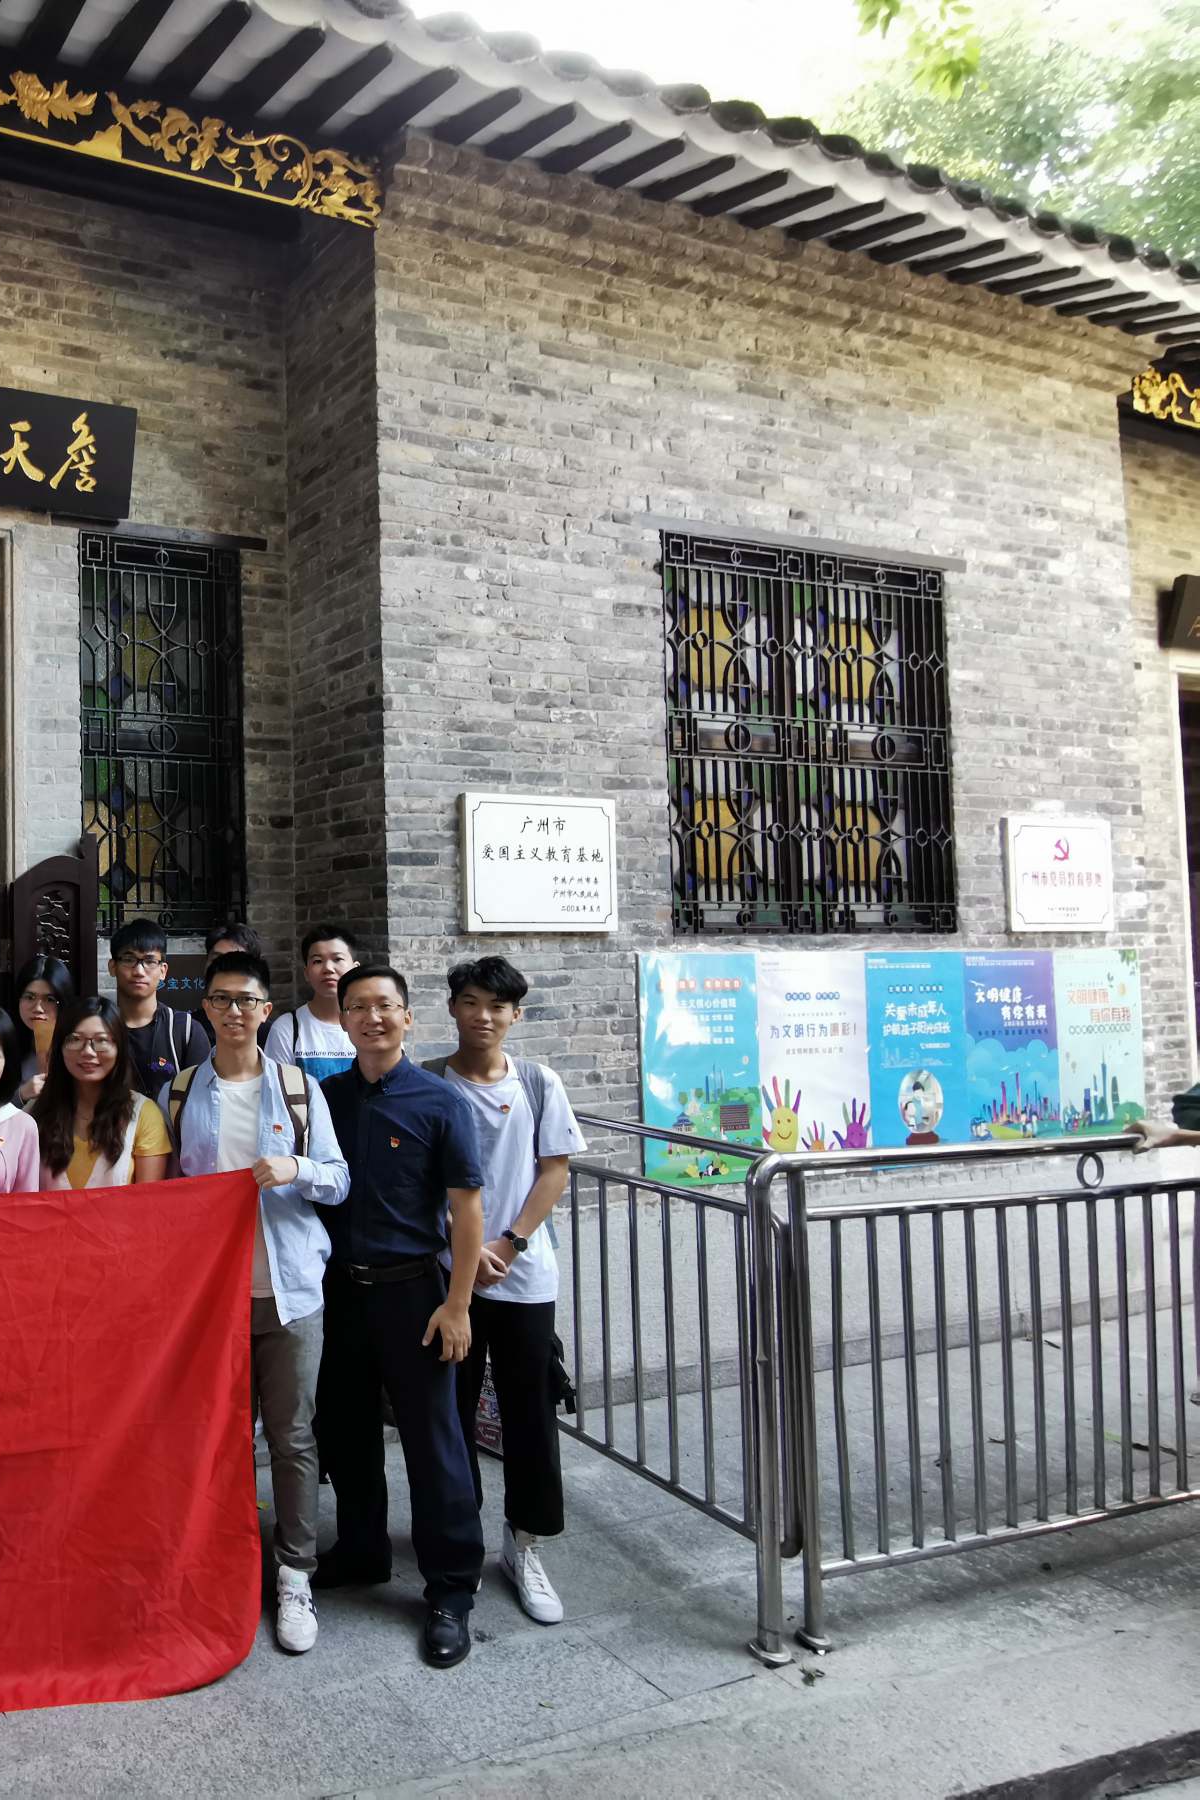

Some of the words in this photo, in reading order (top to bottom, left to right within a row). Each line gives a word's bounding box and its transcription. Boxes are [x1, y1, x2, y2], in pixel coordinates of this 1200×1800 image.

[520, 816, 566, 836] 广州市
[481, 844, 603, 863] 爱国主义教育基地
[666, 998, 736, 1009] 主义核心价值观
[975, 986, 1022, 1004] 文明健康
[1001, 1004, 1047, 1020] 有你有我
